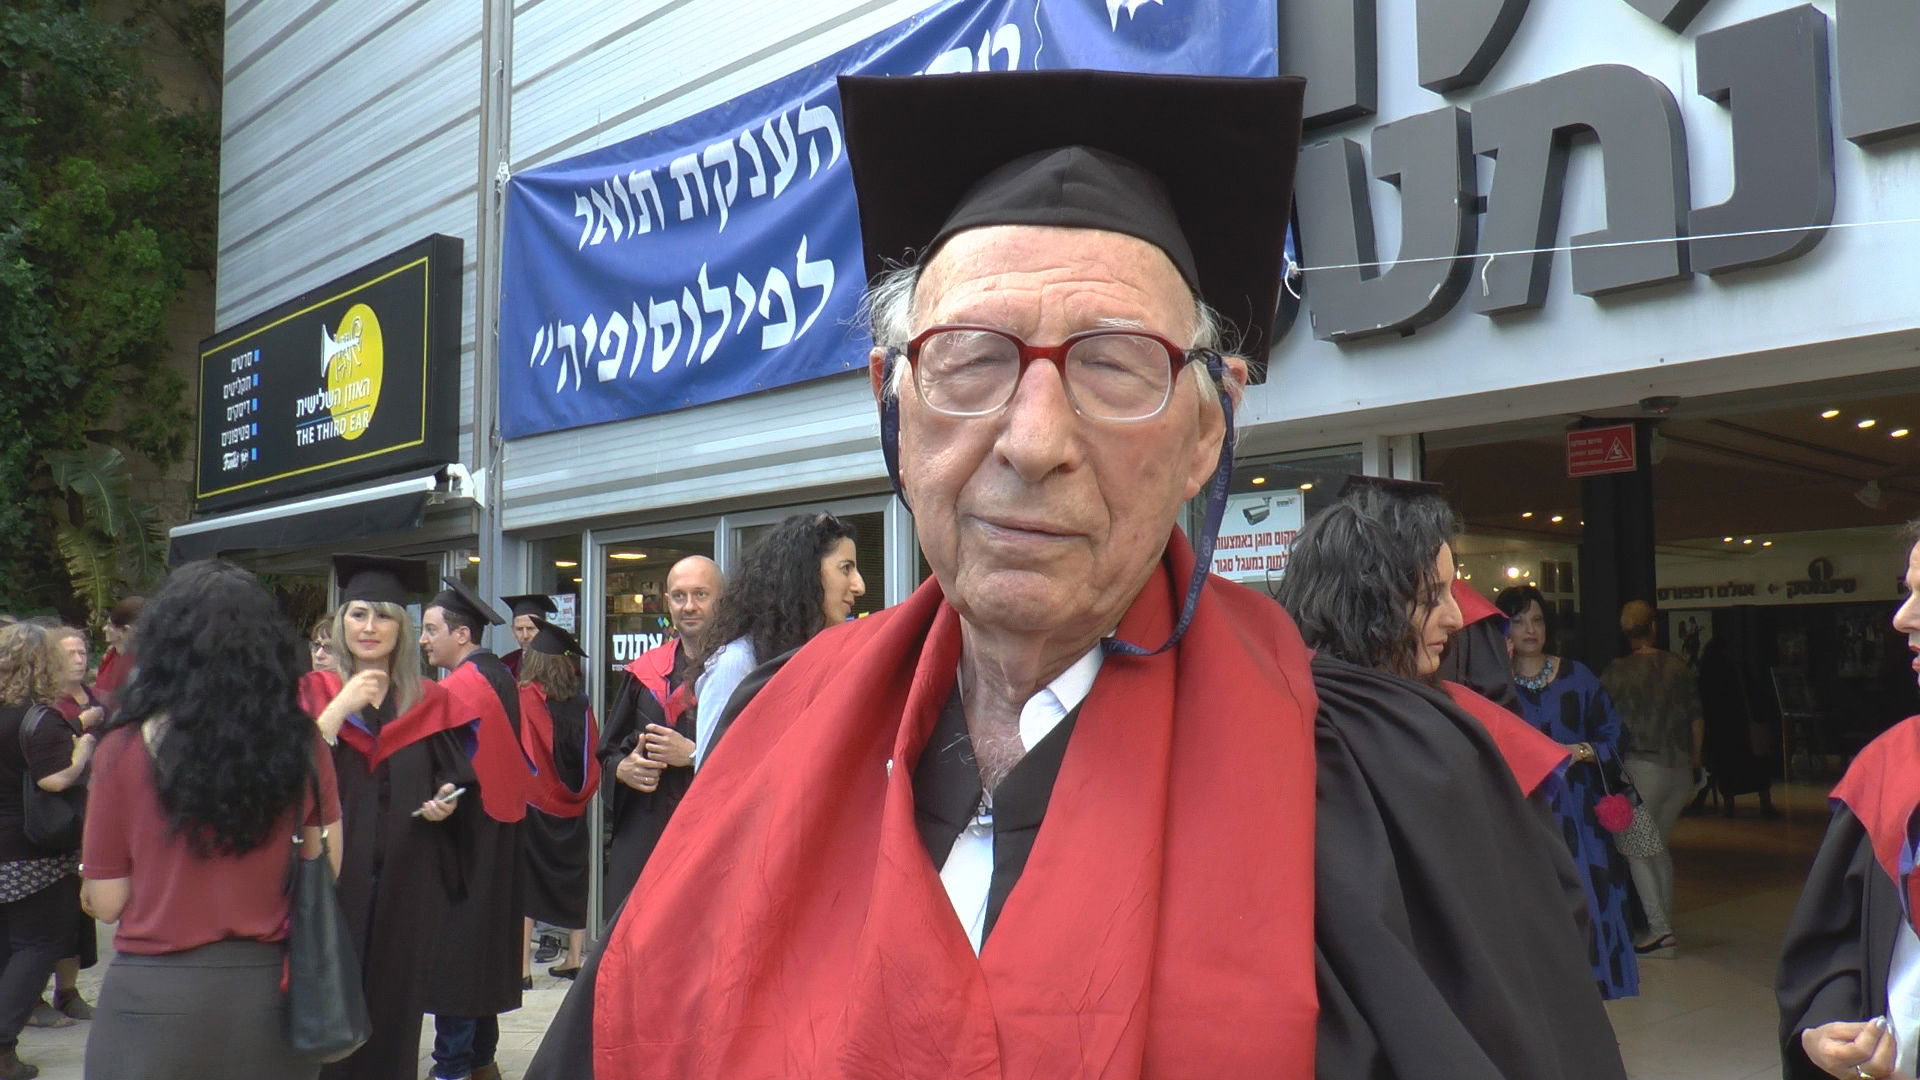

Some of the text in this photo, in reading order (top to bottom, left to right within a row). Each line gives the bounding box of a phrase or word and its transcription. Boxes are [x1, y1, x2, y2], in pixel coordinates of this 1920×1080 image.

[574, 101, 842, 252] הענקת תואר
[231, 351, 253, 373] סרטים
[223, 376, 251, 400] תקליטים
[296, 378, 371, 418] האוזן השלישית
[226, 399, 251, 422] דיסקים
[221, 424, 250, 447] פטיפונים
[296, 410, 370, 447] THE THIRD EAR
[1255, 532, 1273, 552] מוגן
[1214, 551, 1288, 575] למות במעגל סגור
[612, 632, 663, 661] אתוס
